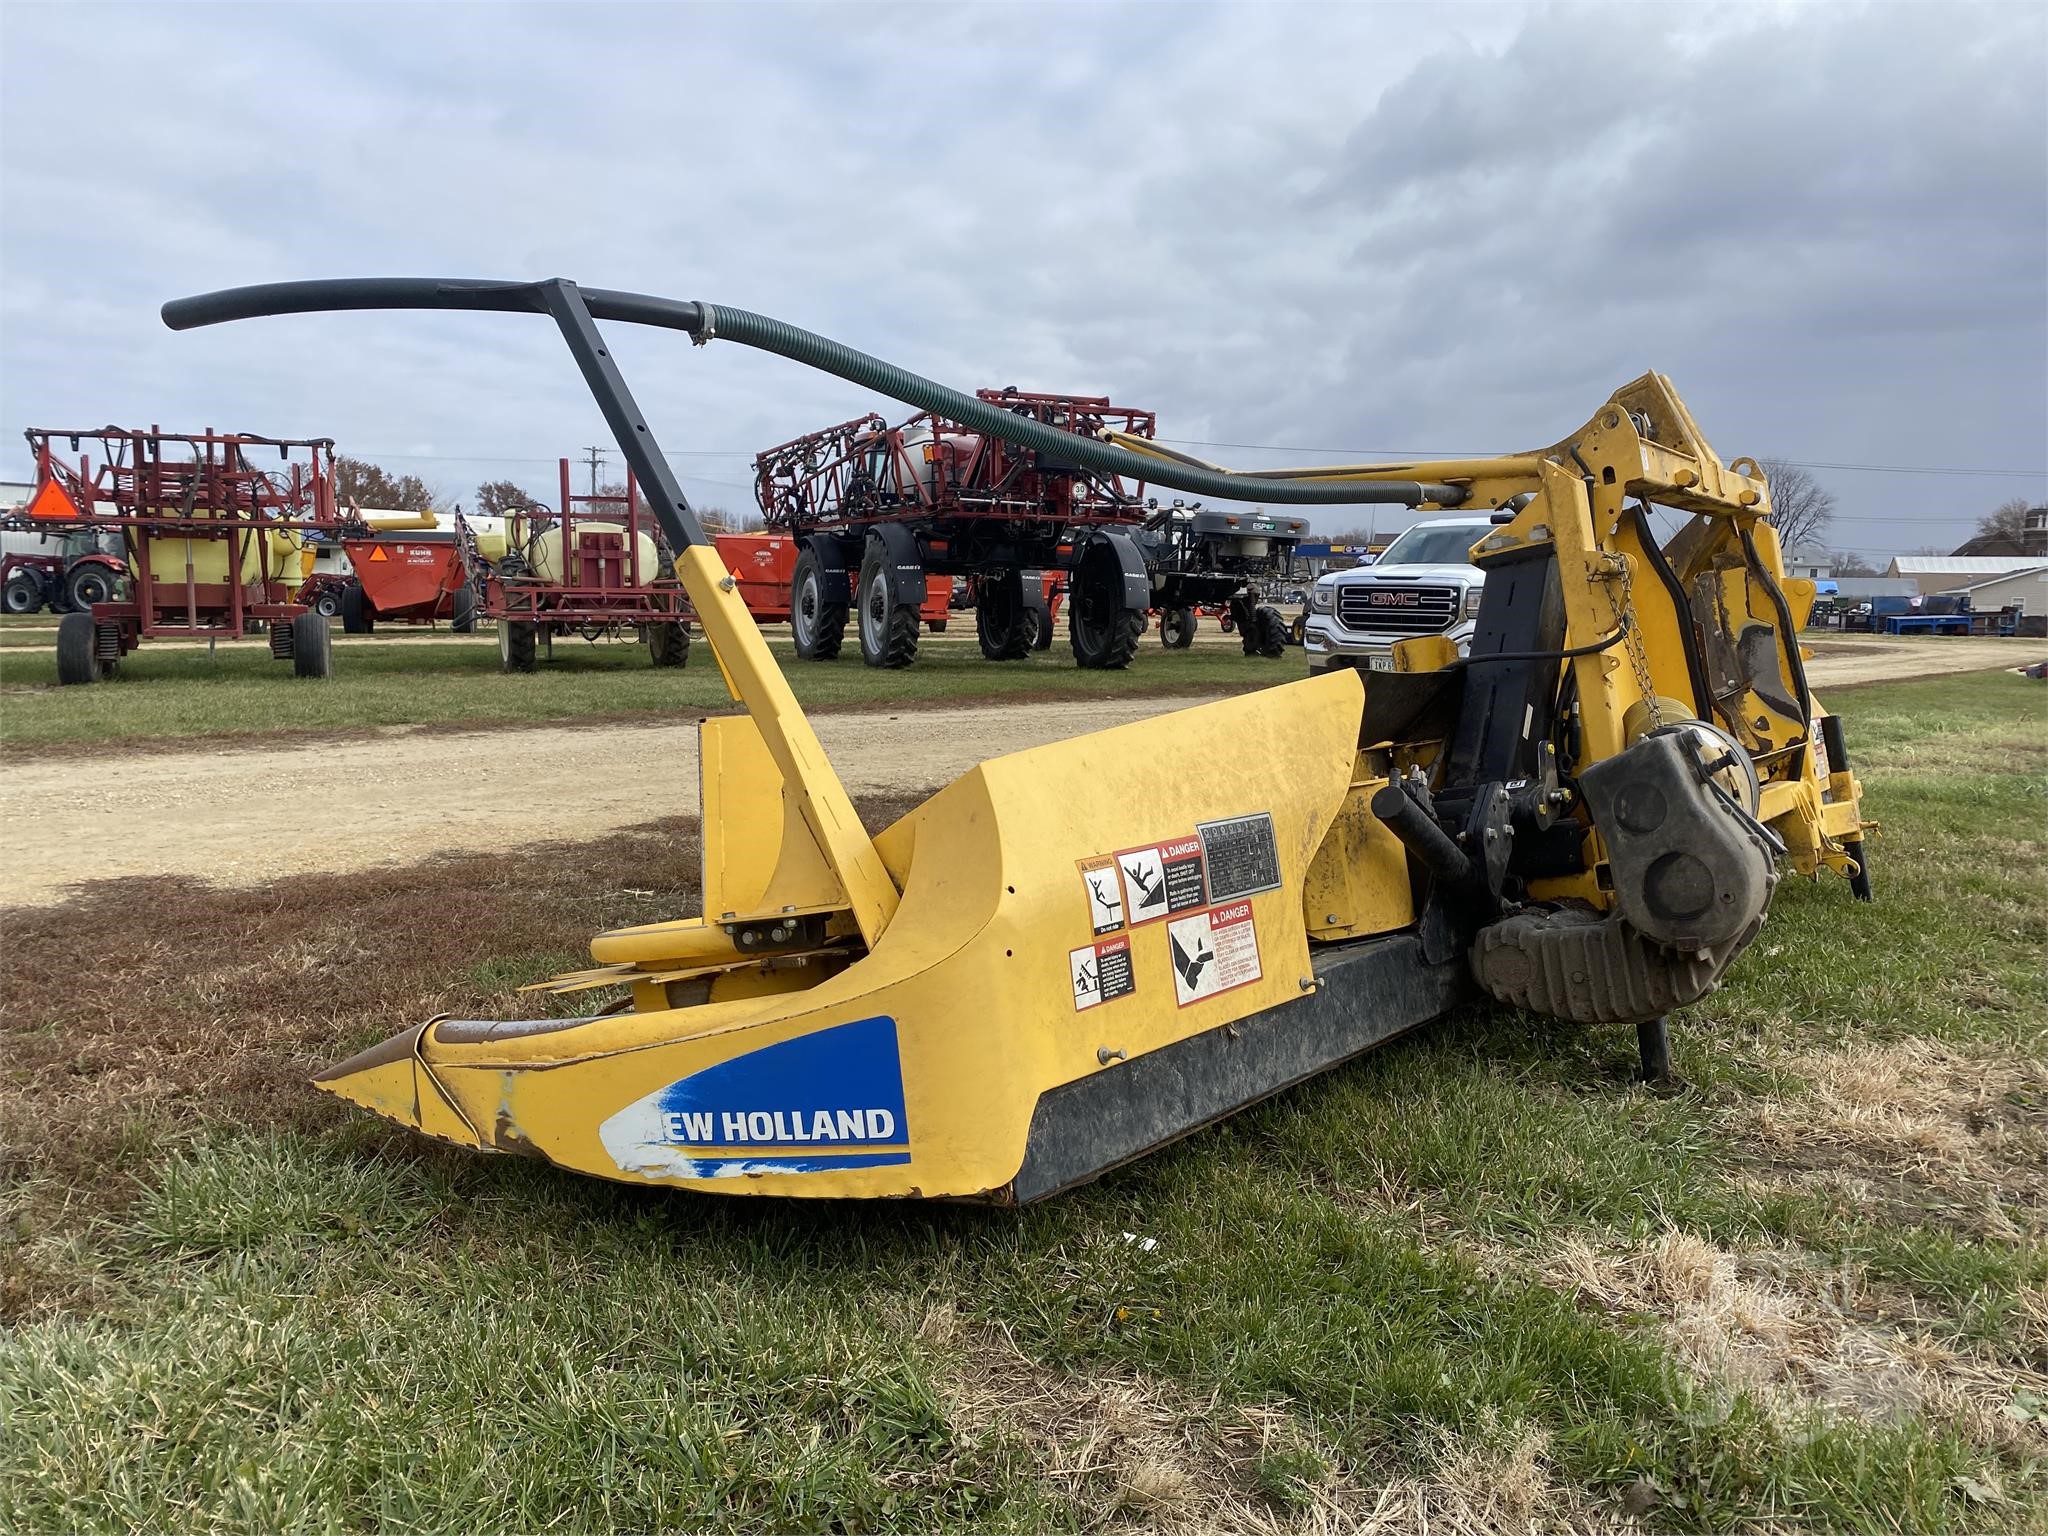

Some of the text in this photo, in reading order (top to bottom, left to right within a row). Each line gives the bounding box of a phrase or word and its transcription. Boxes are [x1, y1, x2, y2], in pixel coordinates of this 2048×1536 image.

[1370, 592, 1419, 606] GMC
[1169, 842, 1200, 856] DANGER
[1087, 858, 1112, 868] WARNING
[1220, 904, 1250, 922] DANGER
[1106, 942, 1125, 953] DANGER
[661, 1108, 896, 1142] EW HOLLAND
